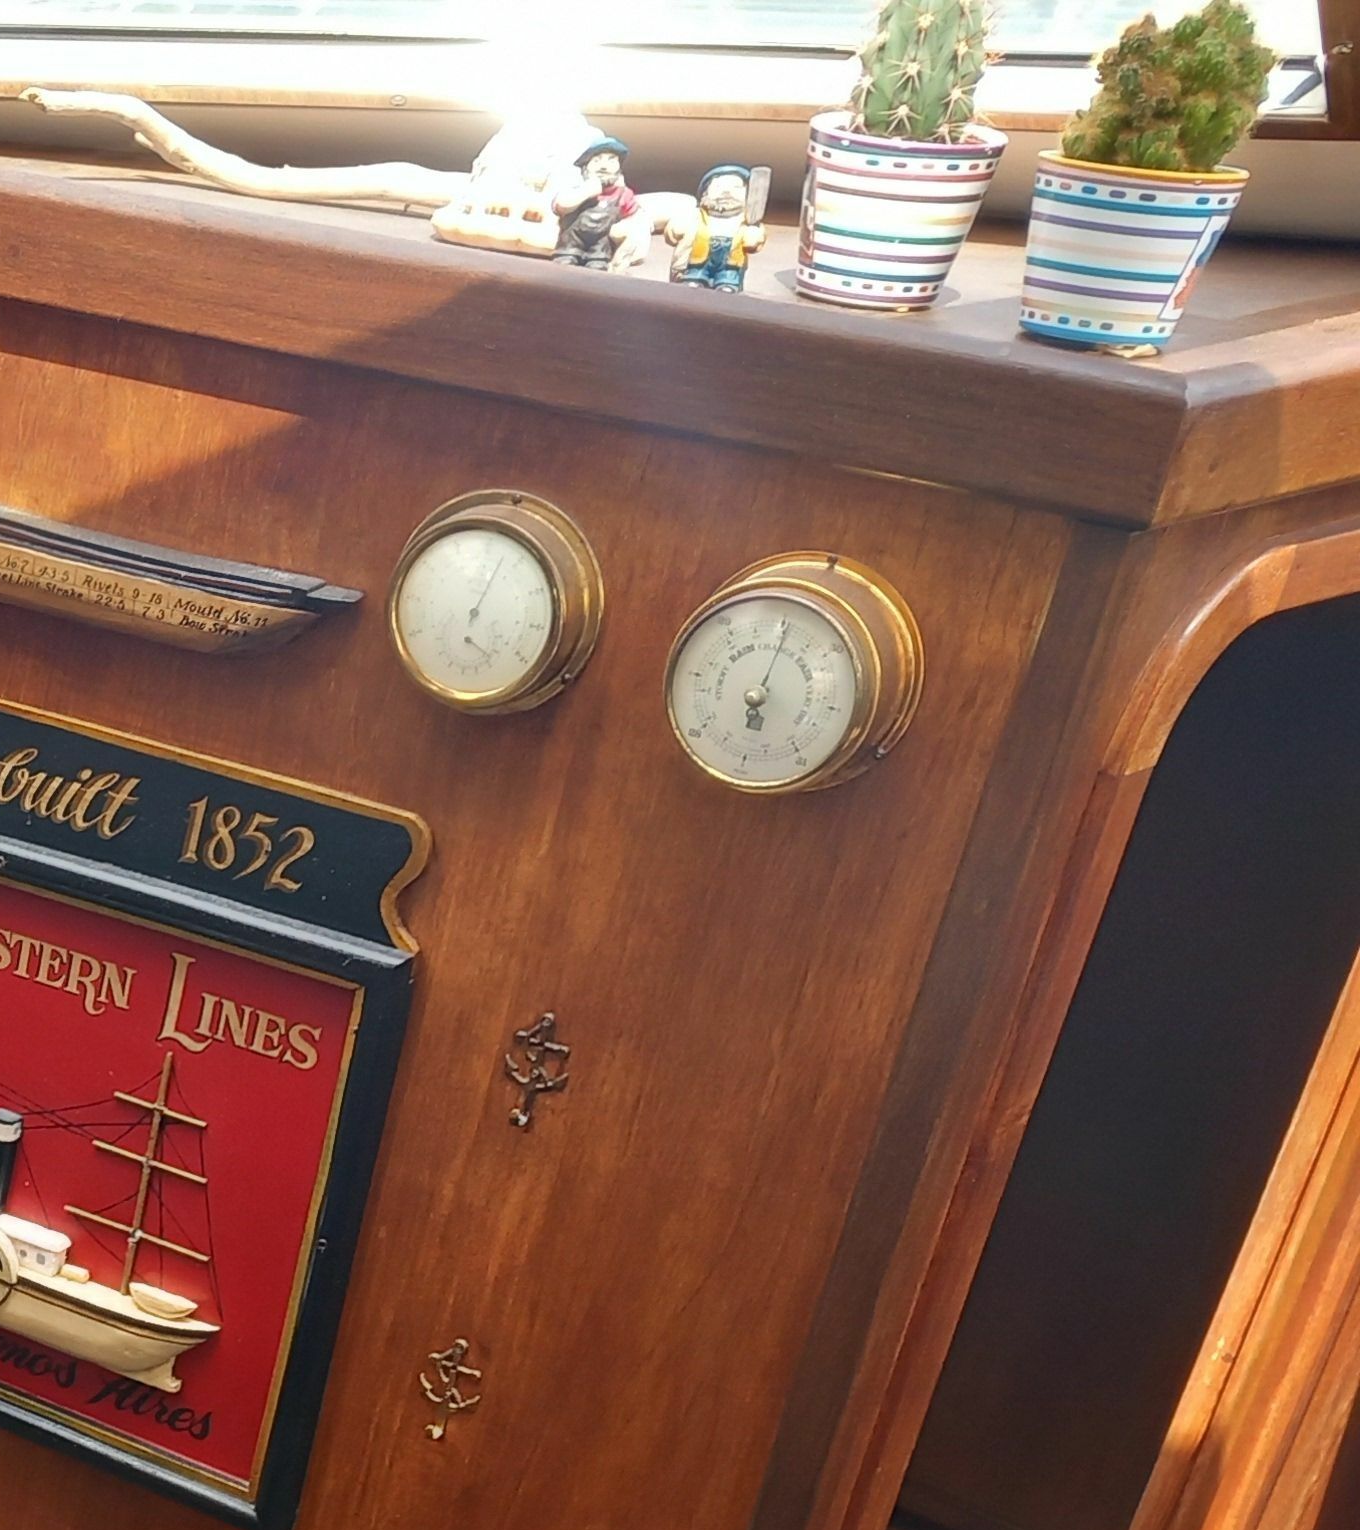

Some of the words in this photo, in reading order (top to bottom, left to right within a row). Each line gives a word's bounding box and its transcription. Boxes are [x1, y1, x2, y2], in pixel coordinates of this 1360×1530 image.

[173, 597, 224, 619] Mould
[177, 796, 316, 893] 1852
[156, 951, 323, 1071] LINES
[88, 1377, 214, 1441] Aires
